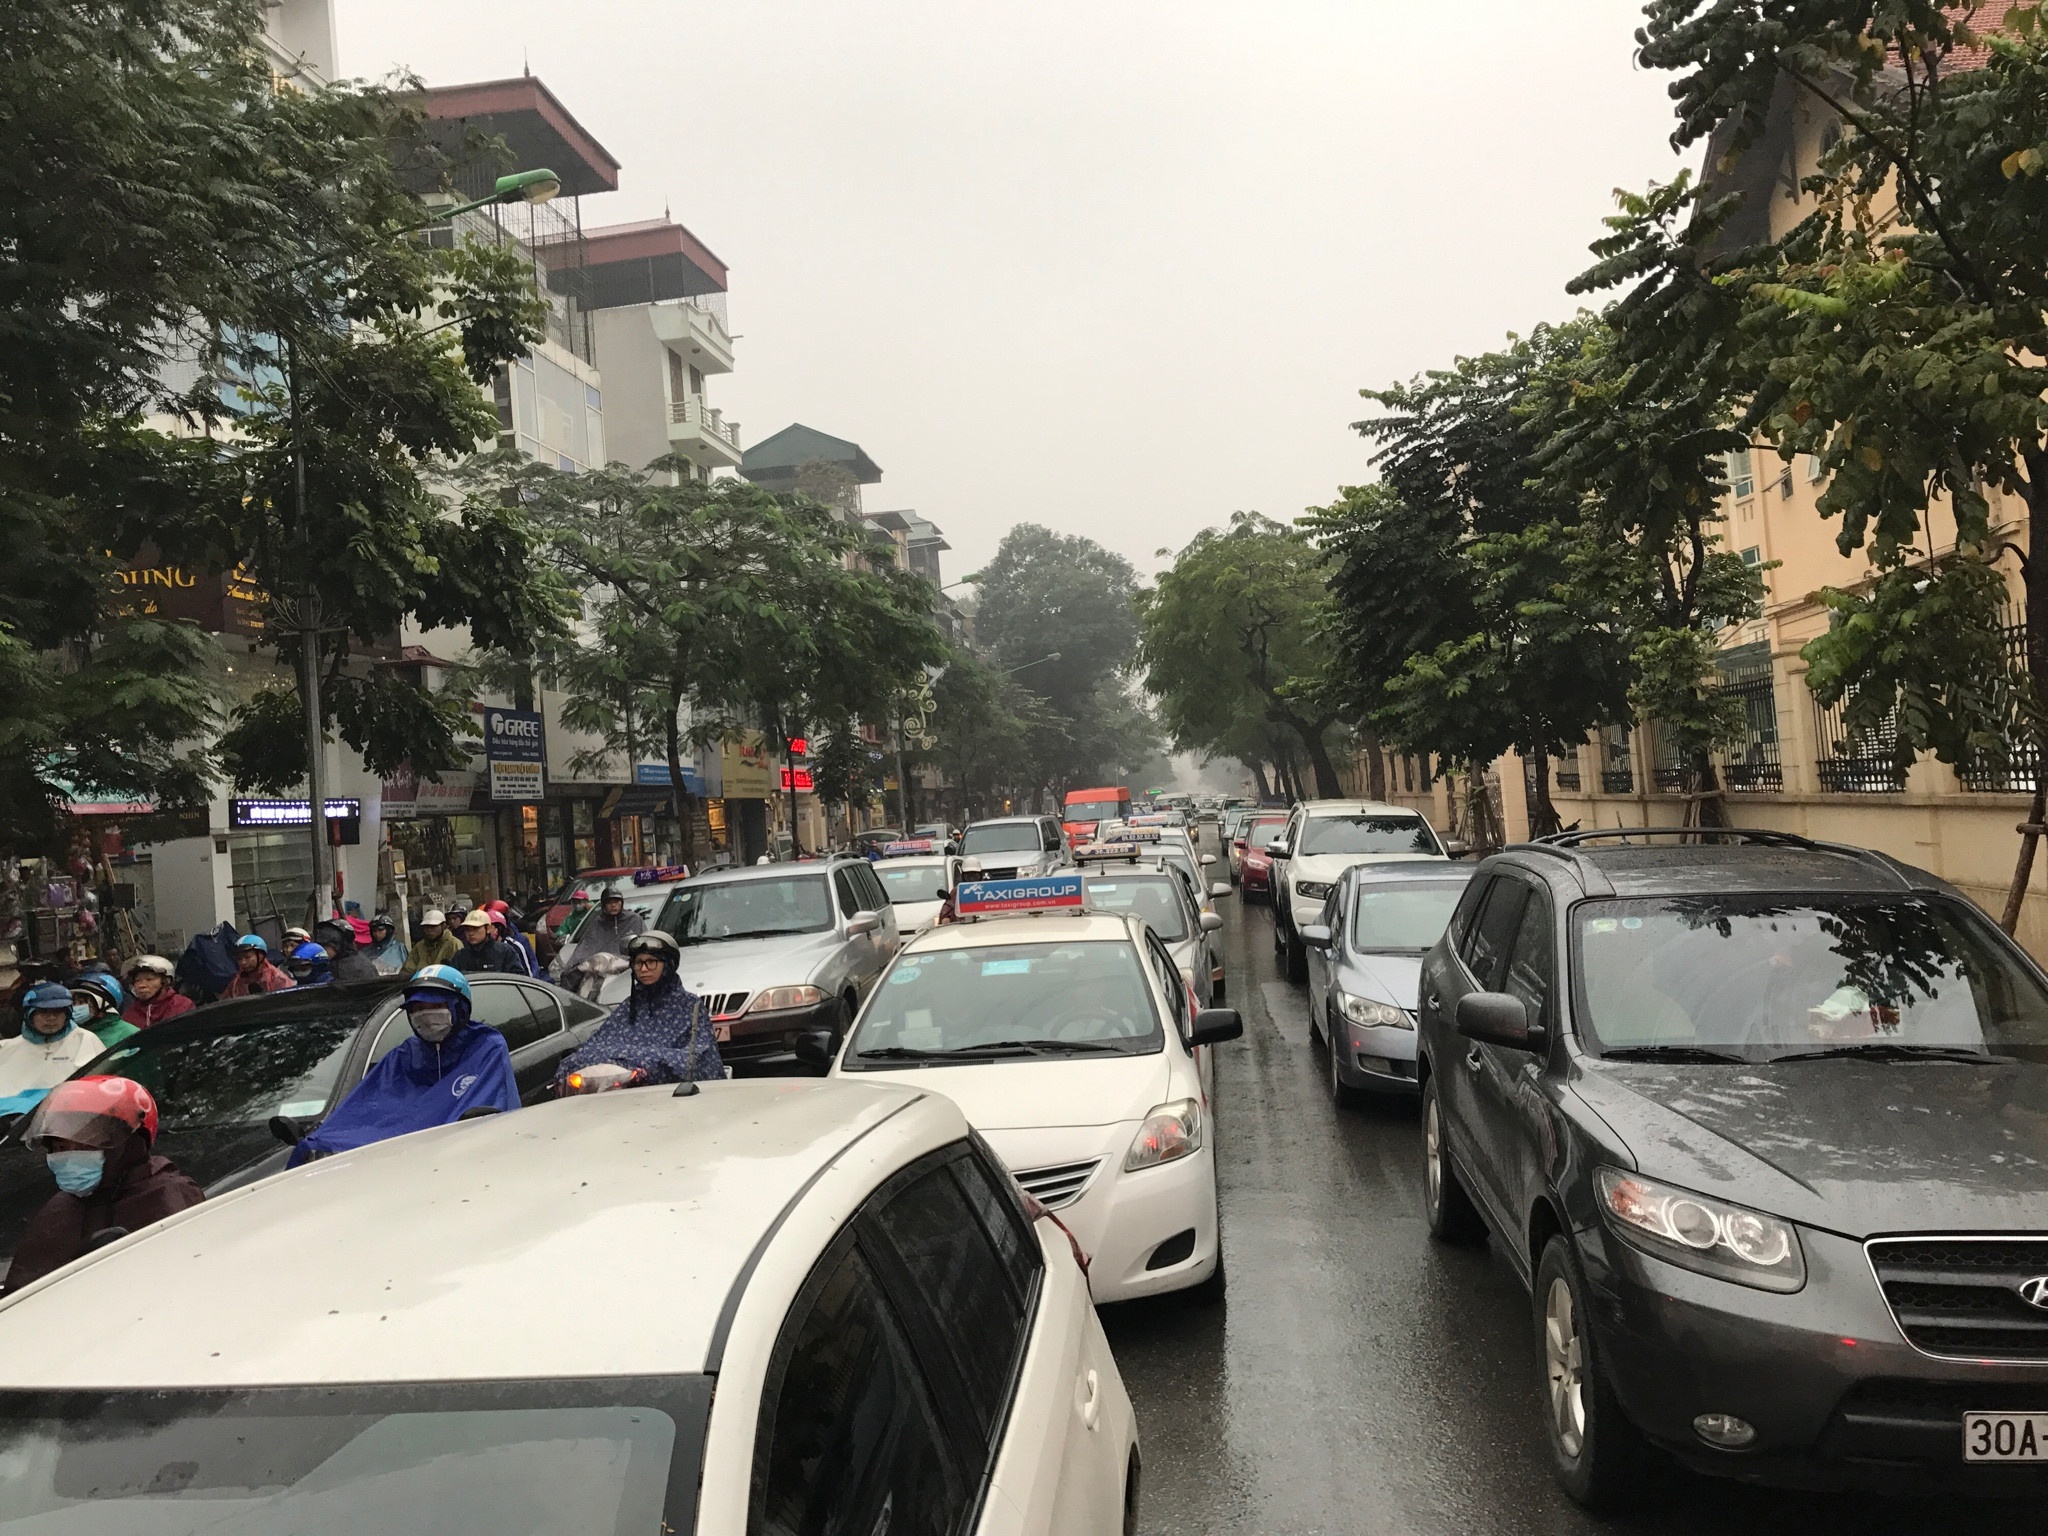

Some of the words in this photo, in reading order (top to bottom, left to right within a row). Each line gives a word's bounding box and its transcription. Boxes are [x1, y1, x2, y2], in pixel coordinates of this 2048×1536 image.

[504, 719, 539, 738] GREE
[973, 885, 1077, 901] TAXIGROUP
[984, 900, 1056, 909] www.taxigroup.com.vn
